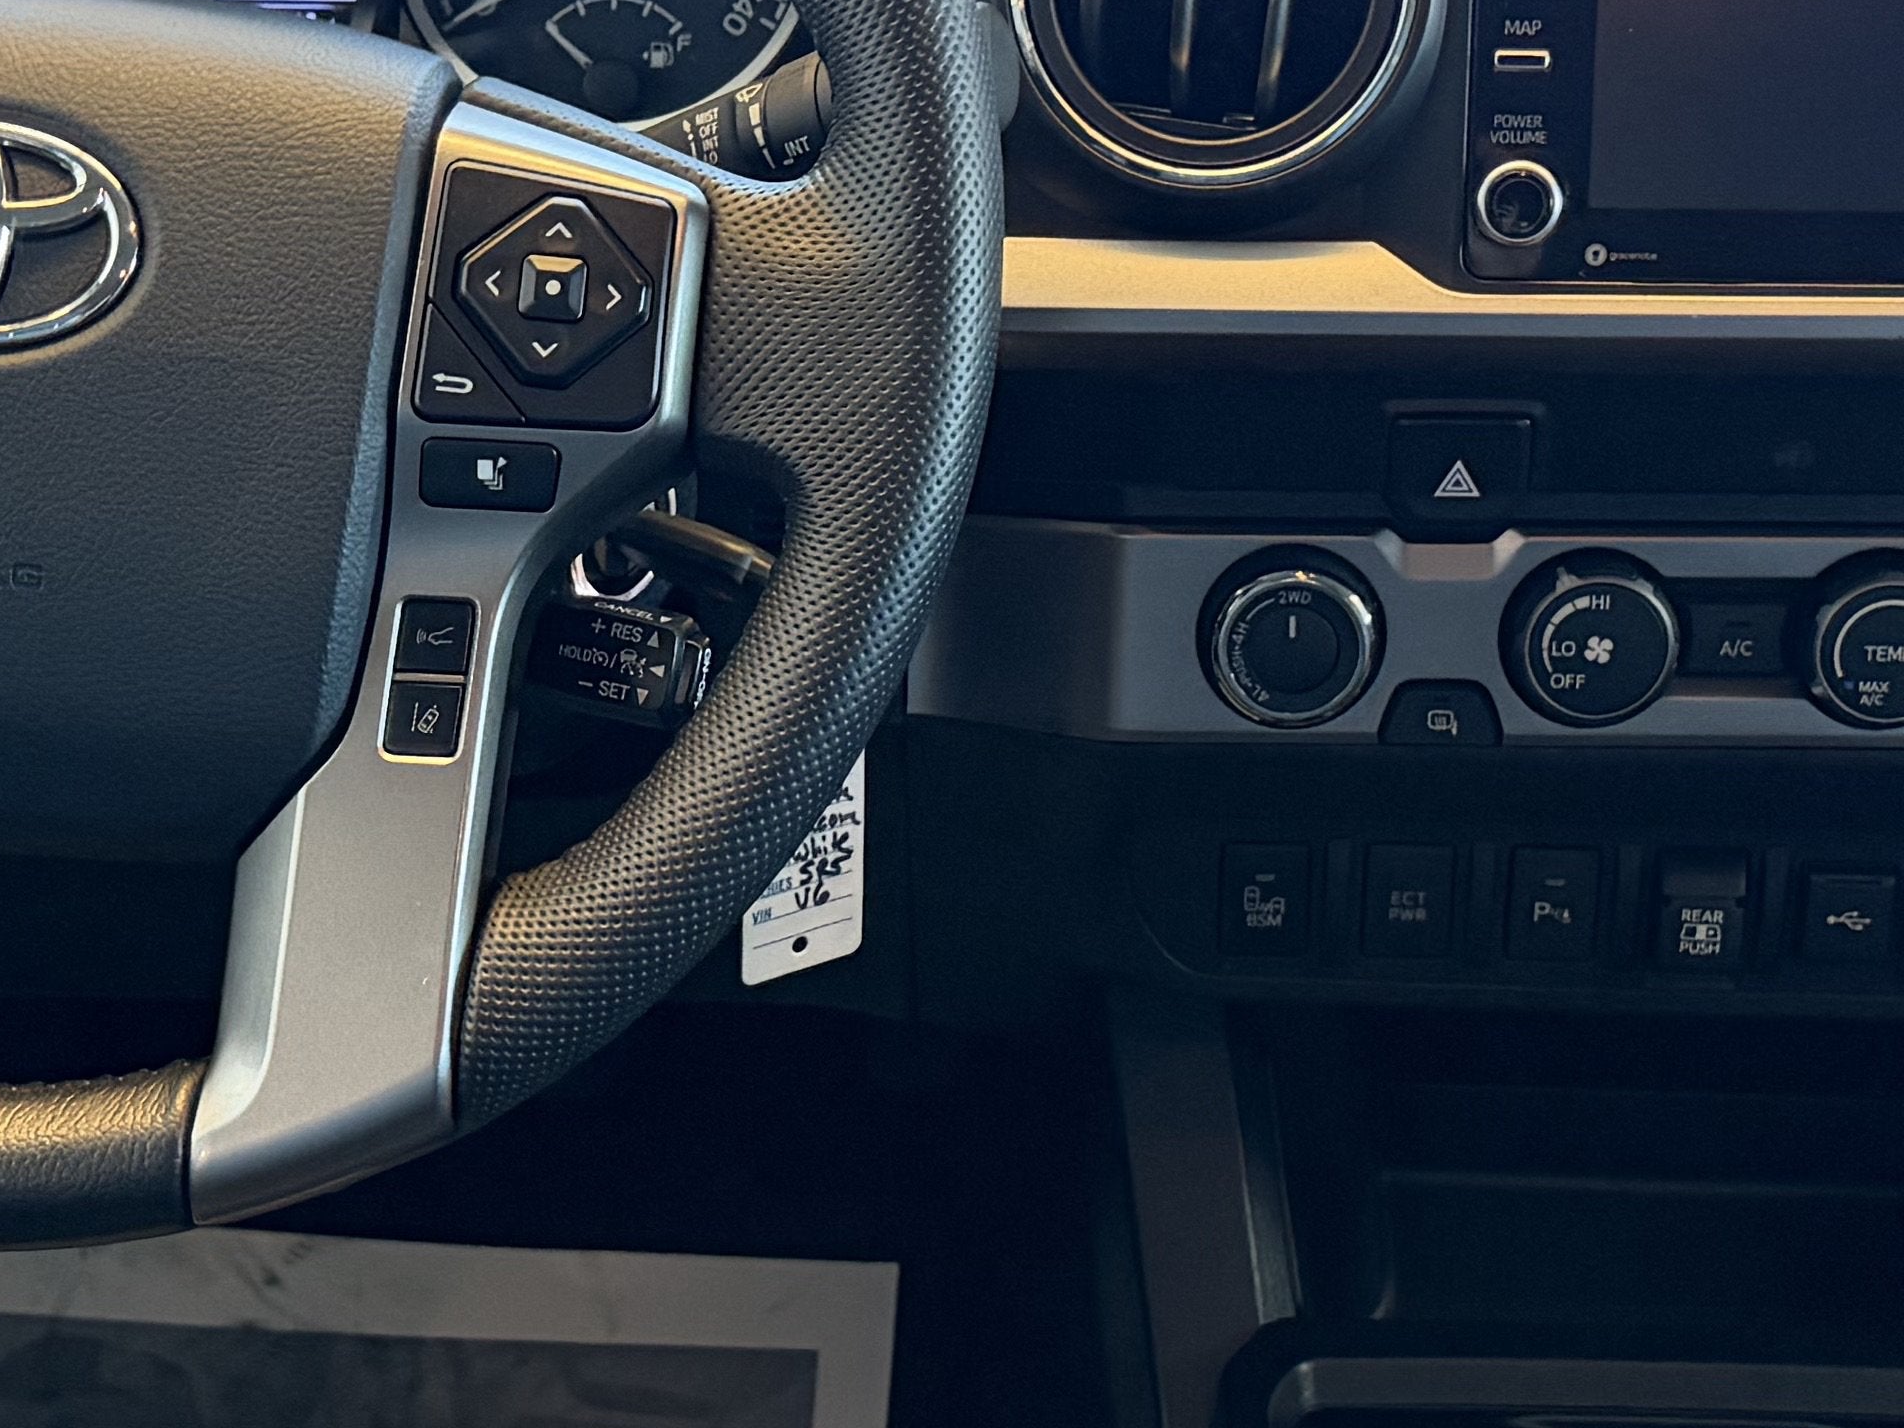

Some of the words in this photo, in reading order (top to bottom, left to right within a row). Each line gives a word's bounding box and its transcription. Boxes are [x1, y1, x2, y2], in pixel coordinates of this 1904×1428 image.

[1504, 19, 1543, 36] MAP
[676, 33, 692, 52] F
[1494, 114, 1544, 129] POWER
[698, 121, 719, 139] OFF
[1490, 130, 1548, 146] VOLUME
[1277, 590, 1313, 605] 2WD
[1590, 594, 1611, 610] HI
[594, 601, 655, 621] CANCEL
[610, 622, 644, 643] RES
[558, 644, 593, 663] HOLD
[1551, 640, 1576, 657] LO
[1719, 640, 1754, 657] A/C
[1550, 674, 1586, 690] OFF
[1858, 681, 1890, 694] MAX
[598, 680, 631, 701] SET
[1859, 694, 1884, 707] A/C
[1390, 890, 1427, 906] ECT
[751, 907, 773, 925] VIN
[1246, 913, 1283, 927] BSM
[1388, 907, 1428, 922] PWR
[1681, 908, 1725, 924] REAR
[1679, 940, 1721, 956] PUSH
